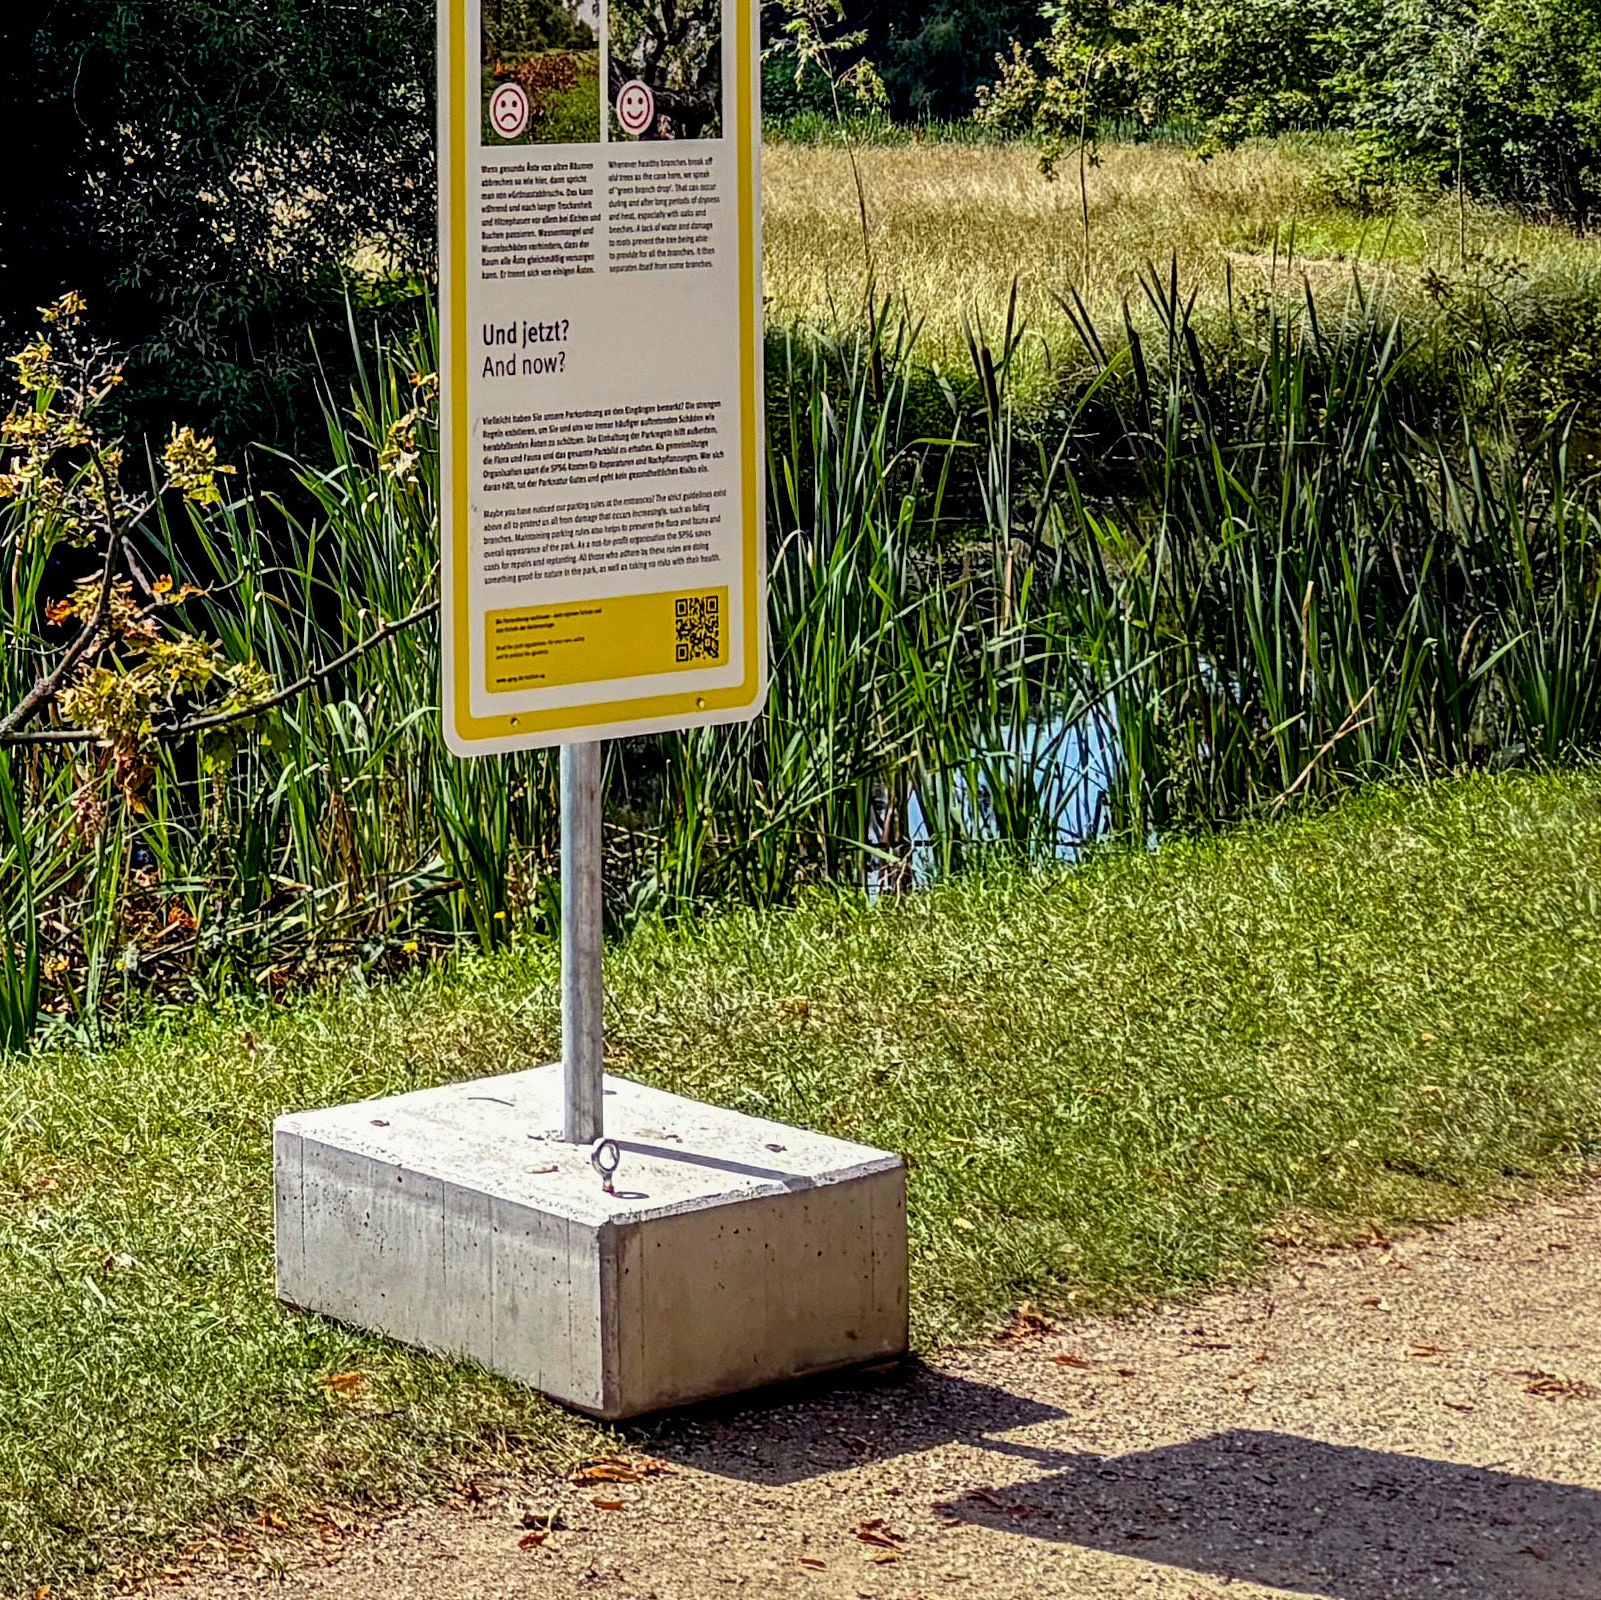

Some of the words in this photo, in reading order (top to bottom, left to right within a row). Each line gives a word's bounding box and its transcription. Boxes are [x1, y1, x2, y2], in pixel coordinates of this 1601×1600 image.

[482, 320, 518, 346] Und
[521, 318, 570, 350] jetzt?
[482, 353, 517, 379] And
[522, 351, 566, 376] now?
